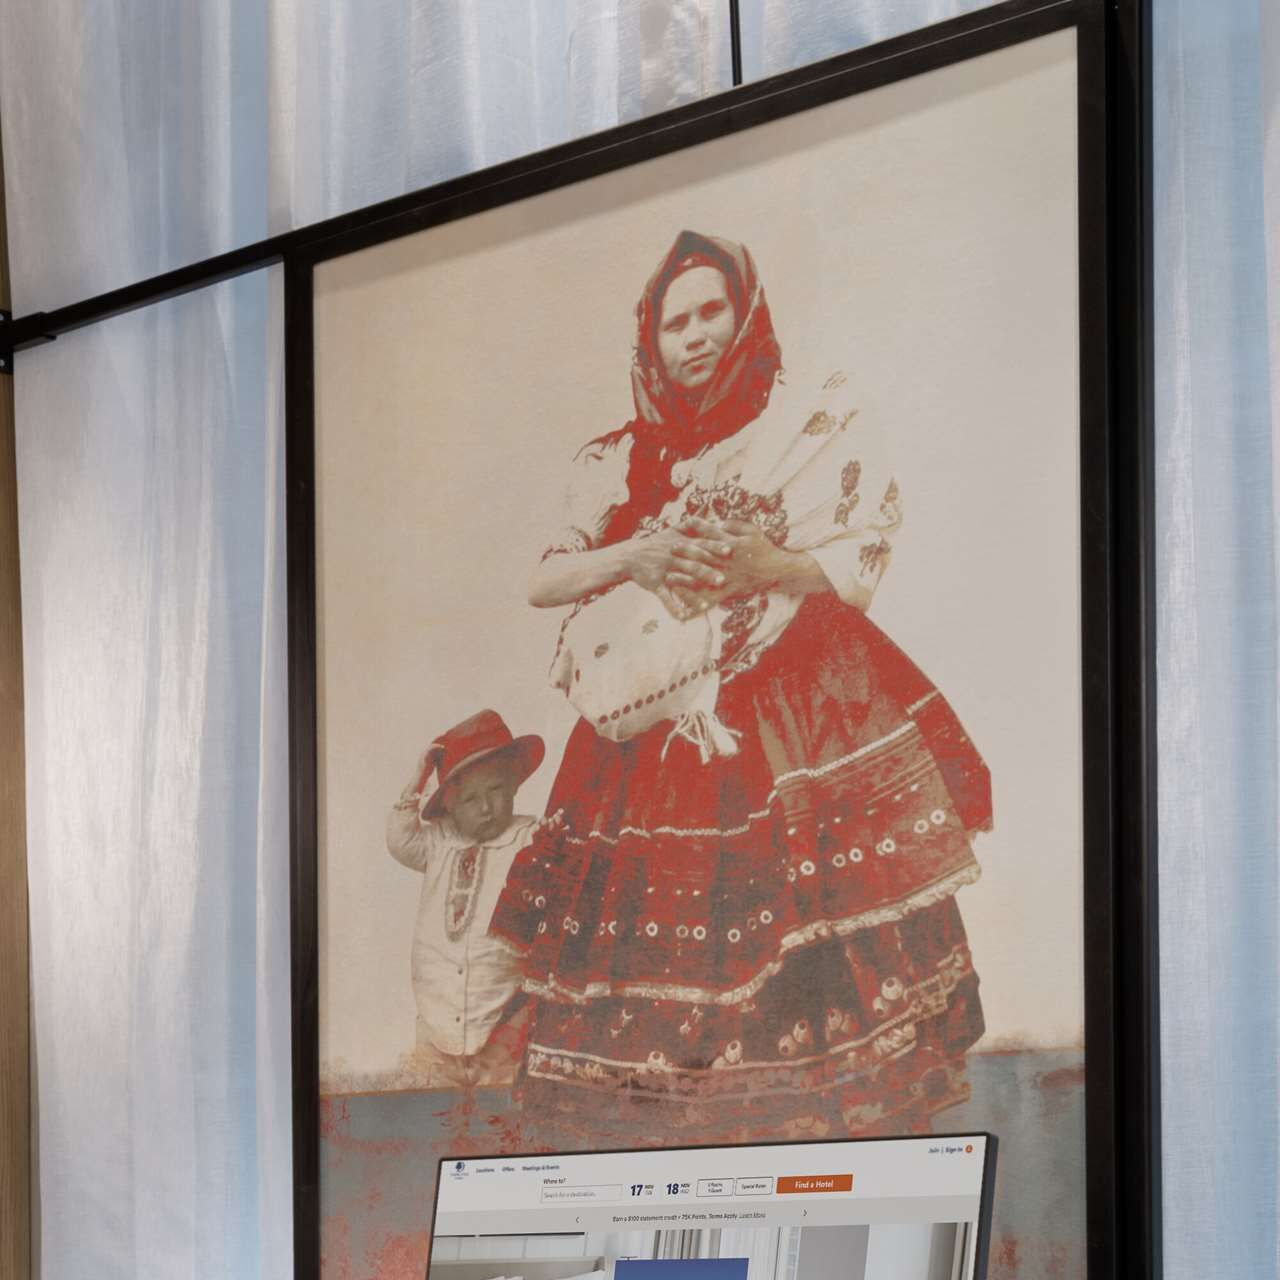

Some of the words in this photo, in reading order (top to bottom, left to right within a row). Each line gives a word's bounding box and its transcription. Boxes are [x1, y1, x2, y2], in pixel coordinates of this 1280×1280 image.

[631, 1184, 643, 1196] 17
[666, 1183, 679, 1195] 18
[795, 1180, 809, 1189] Find
[815, 1179, 834, 1188] Hotel
